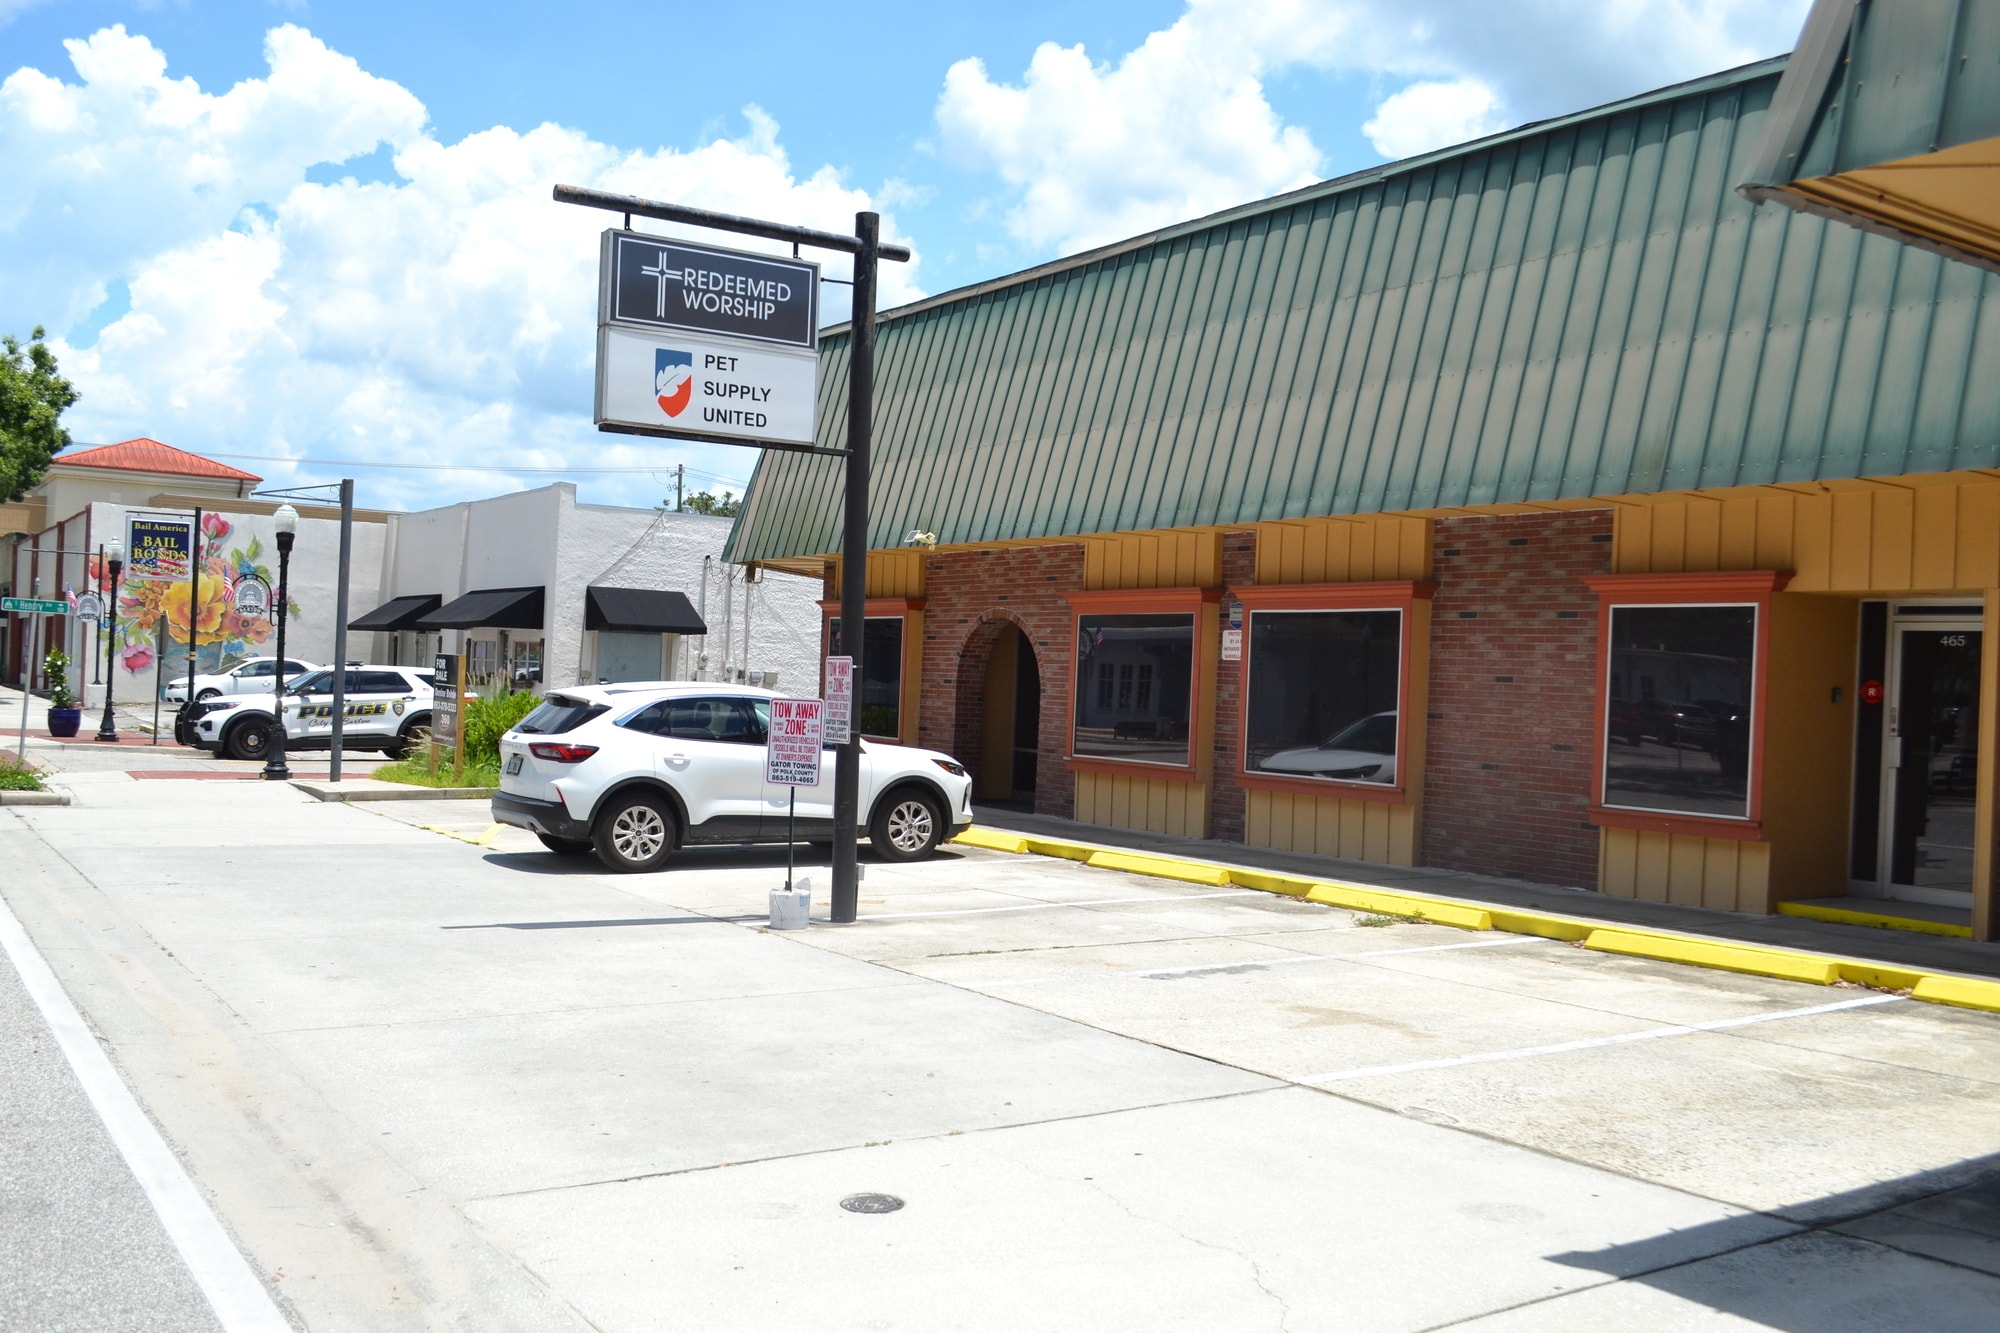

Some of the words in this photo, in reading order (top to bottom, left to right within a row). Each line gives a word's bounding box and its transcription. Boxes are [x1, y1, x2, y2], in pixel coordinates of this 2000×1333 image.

[684, 267, 792, 302] REDEEMED
[682, 289, 775, 320] WORSHIP
[704, 354, 739, 372] PET
[703, 381, 771, 402] SUPPLY
[703, 407, 767, 428] UNITED
[134, 522, 151, 530] Bail
[153, 523, 188, 532] America
[143, 535, 179, 548] BAIL
[133, 548, 187, 561] BONDS
[19, 600, 43, 612] Hendry
[1940, 635, 1965, 647] 465
[436, 658, 446, 669] FOR
[435, 670, 448, 681] SALE
[1867, 687, 1876, 696] R
[296, 702, 388, 719] POICE
[774, 702, 792, 718] TOW
[795, 703, 820, 719] AWAY
[309, 719, 328, 728] City
[784, 719, 806, 735] ZONE
[792, 762, 817, 770] TOWING
